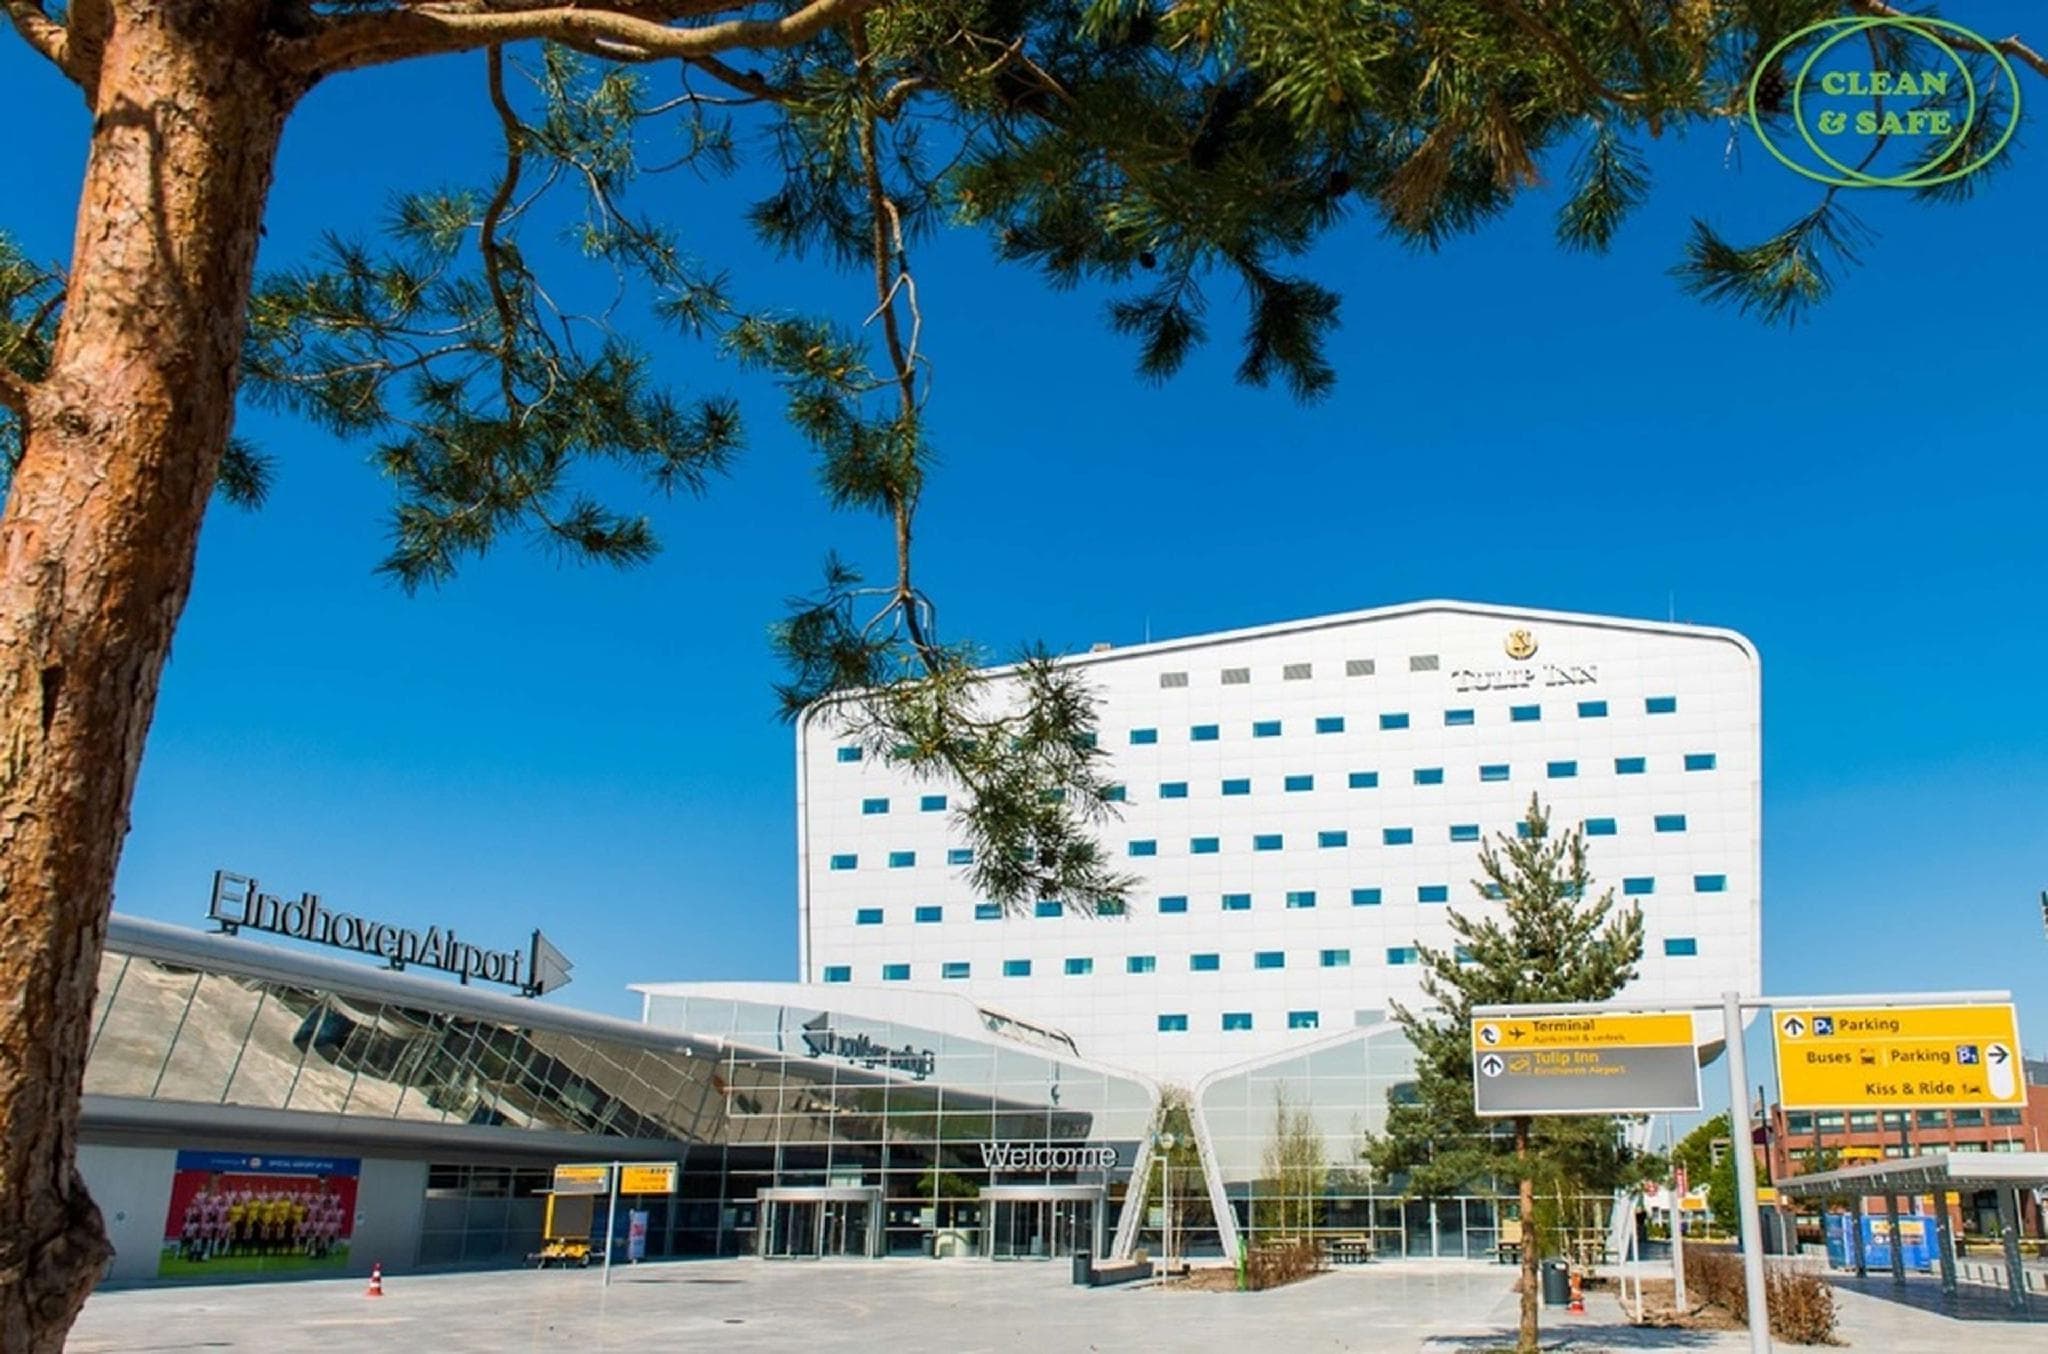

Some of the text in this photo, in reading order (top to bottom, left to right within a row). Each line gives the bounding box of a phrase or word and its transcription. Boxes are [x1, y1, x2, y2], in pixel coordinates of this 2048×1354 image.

[1532, 1019, 1595, 1032] Terminal
[1839, 1018, 1900, 1036] Parking
[1535, 1052, 1599, 1066] Tulip Inn
[1806, 1049, 1852, 1064] Buses
[1891, 1049, 1951, 1065] Parking
[1865, 1080, 1955, 1096] Kiss & Ride
[979, 1142, 1118, 1169] Welcome
